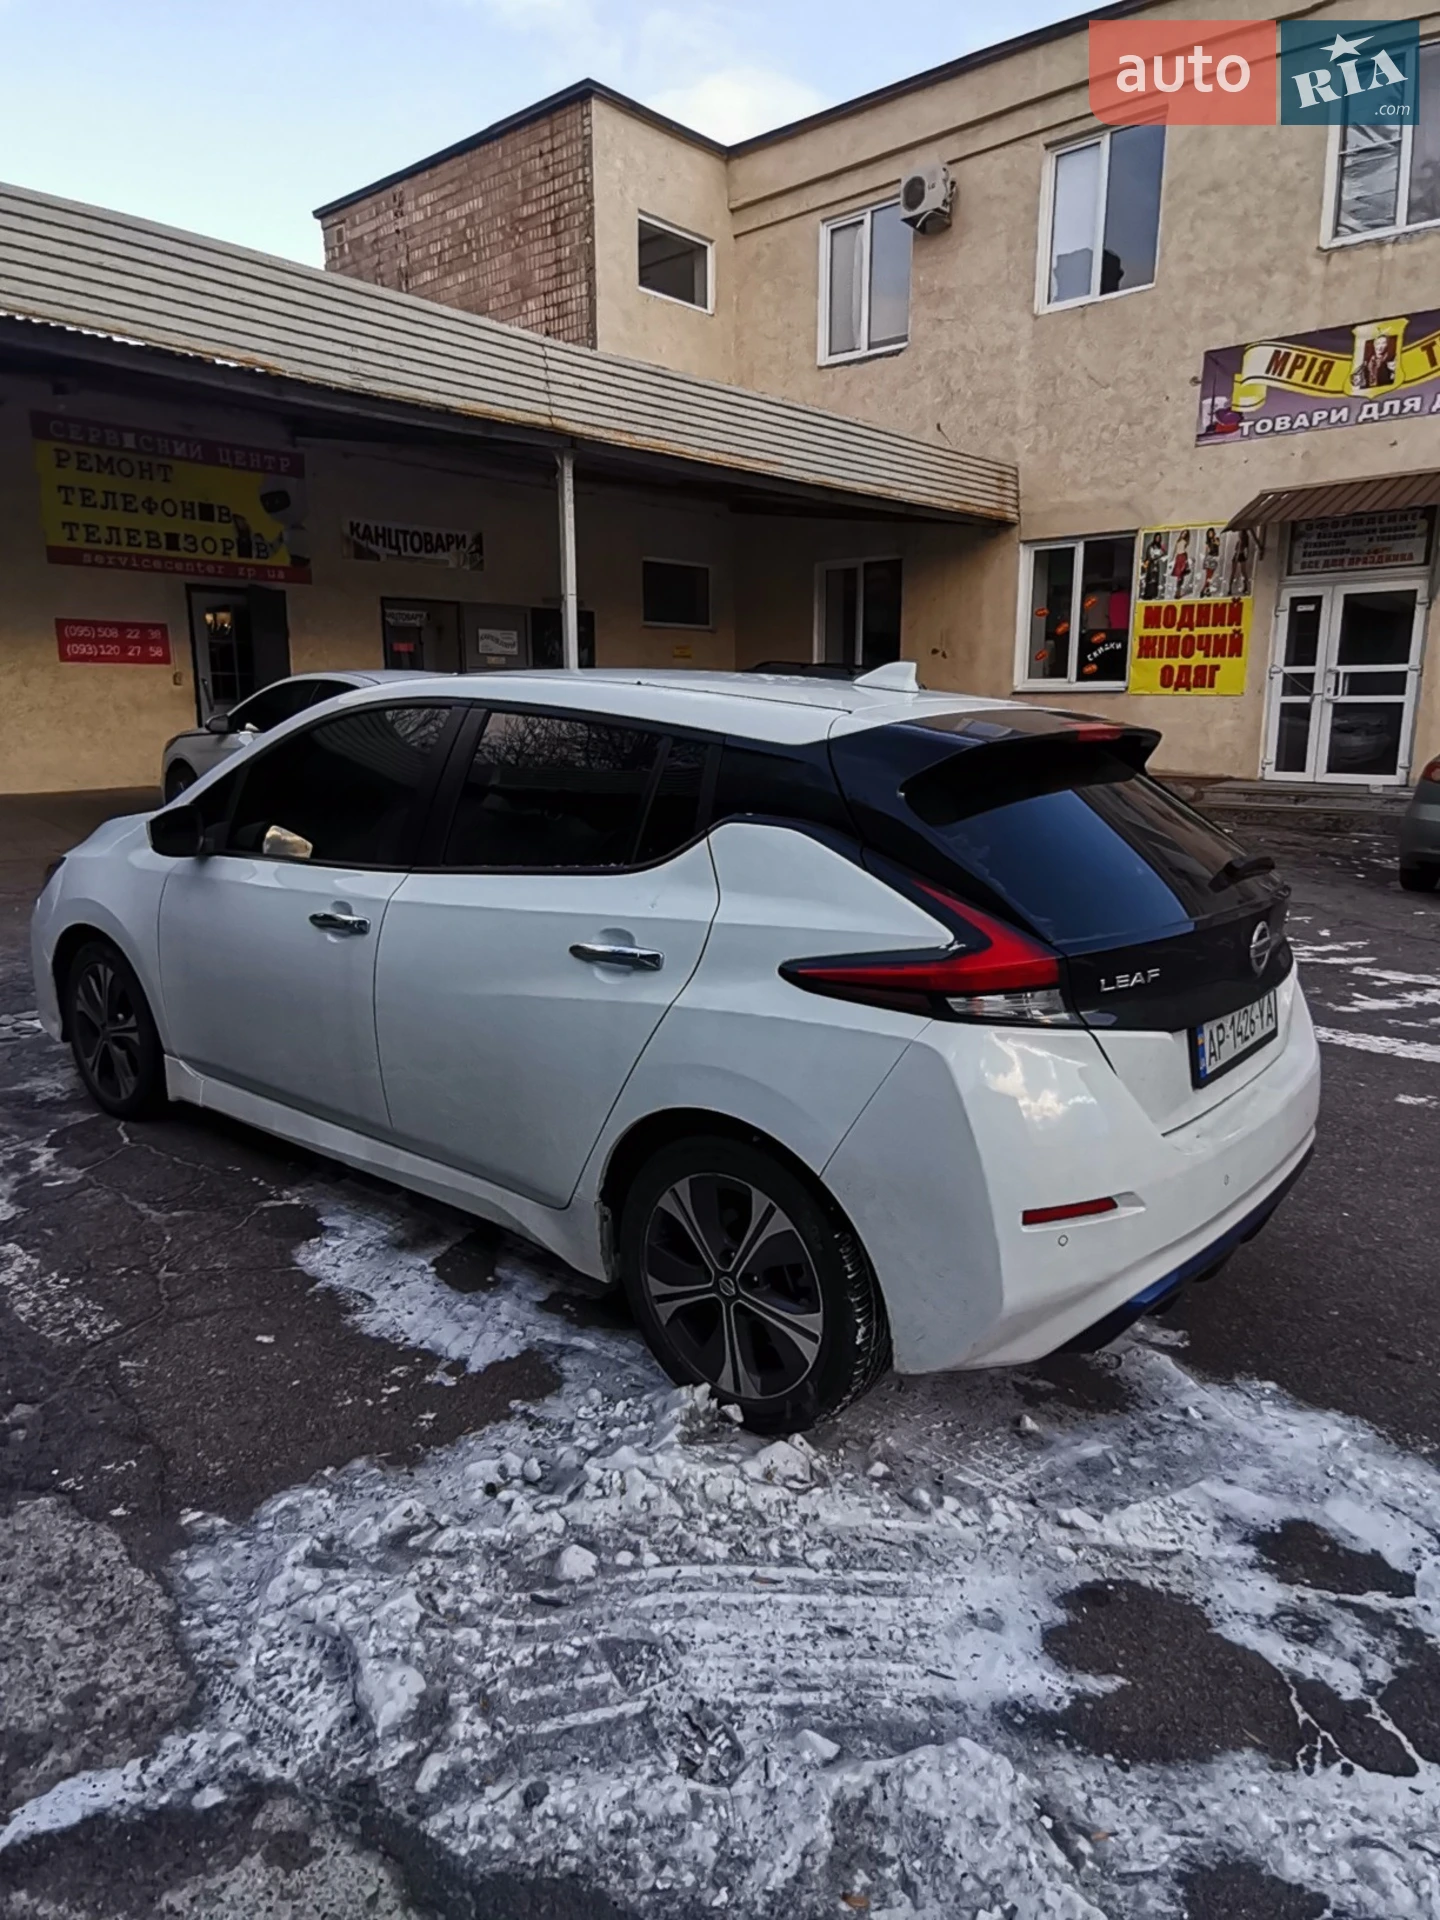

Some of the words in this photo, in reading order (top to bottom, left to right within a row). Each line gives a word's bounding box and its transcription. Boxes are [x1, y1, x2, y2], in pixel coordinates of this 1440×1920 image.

[1264, 349, 1336, 387] МРІЯ
[1239, 406, 1350, 437] ТОВАРИ
[1357, 396, 1422, 424] ДЛЯ
[49, 419, 204, 461] СЕРВСНИЙ
[218, 446, 292, 473] ЦЕНТР
[53, 447, 174, 483] РЕМОНТ
[57, 485, 233, 525] ТЕЛЕФОНВ
[61, 521, 271, 560] ТЕЛЕВЗОРВ
[349, 521, 466, 555] КАНЦТОВАРИ
[1143, 597, 1244, 632] МОДНИЙ
[127, 645, 142, 657] 27
[1137, 628, 1244, 659] ЖІНОЧИЙ
[1160, 664, 1221, 692] ОДЯГ
[1099, 967, 1161, 993] LEAF
